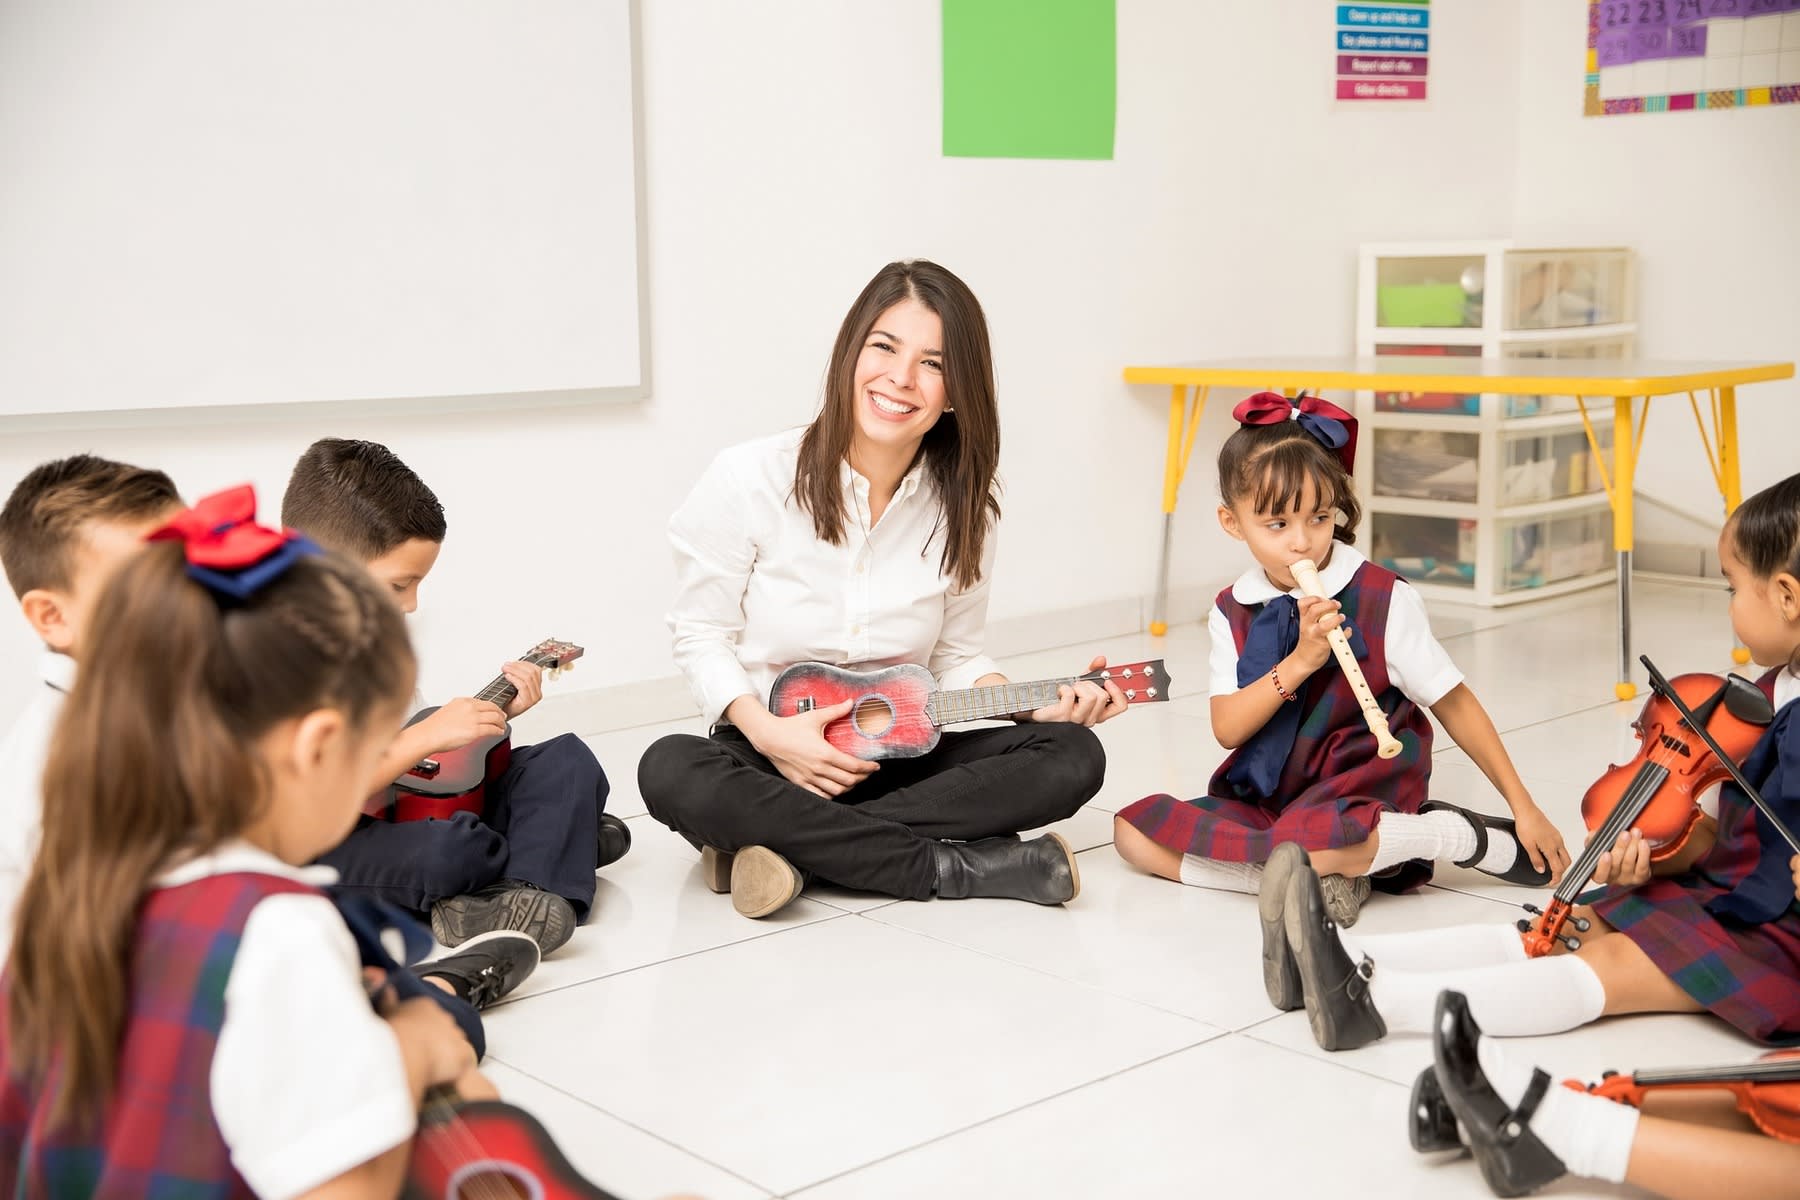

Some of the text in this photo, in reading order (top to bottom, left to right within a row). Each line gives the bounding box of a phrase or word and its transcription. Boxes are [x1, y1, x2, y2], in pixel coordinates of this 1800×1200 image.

[1606, 5, 1631, 27] 22
[1638, 0, 1667, 24] 23
[1676, 0, 1703, 20] 24
[1678, 30, 1699, 51] 31
